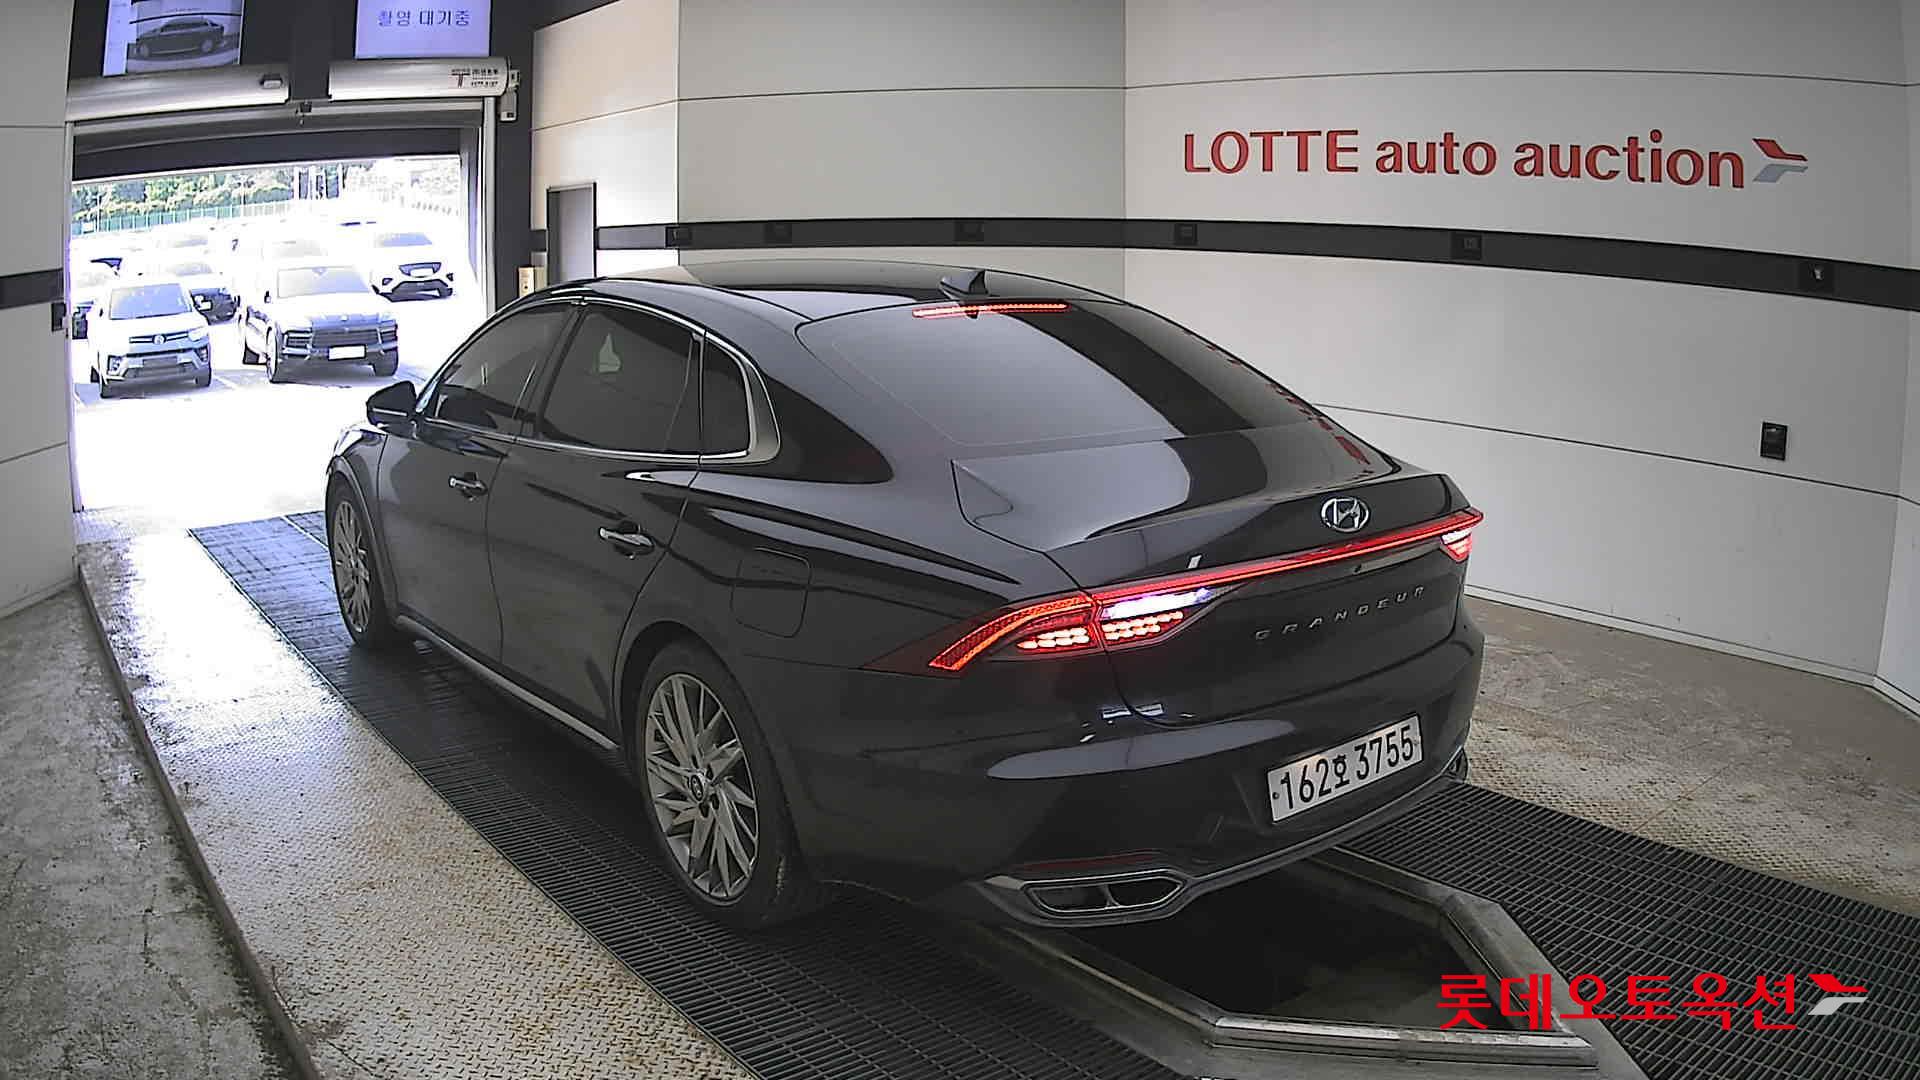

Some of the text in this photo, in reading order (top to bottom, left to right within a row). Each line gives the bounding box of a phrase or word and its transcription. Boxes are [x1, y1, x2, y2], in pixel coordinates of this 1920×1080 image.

[419, 10, 470, 27] 대기중
[1184, 130, 1746, 188] LOTTE auto auction
[1255, 586, 1424, 641] GRANDEUR
[1354, 725, 1414, 780] 3755
